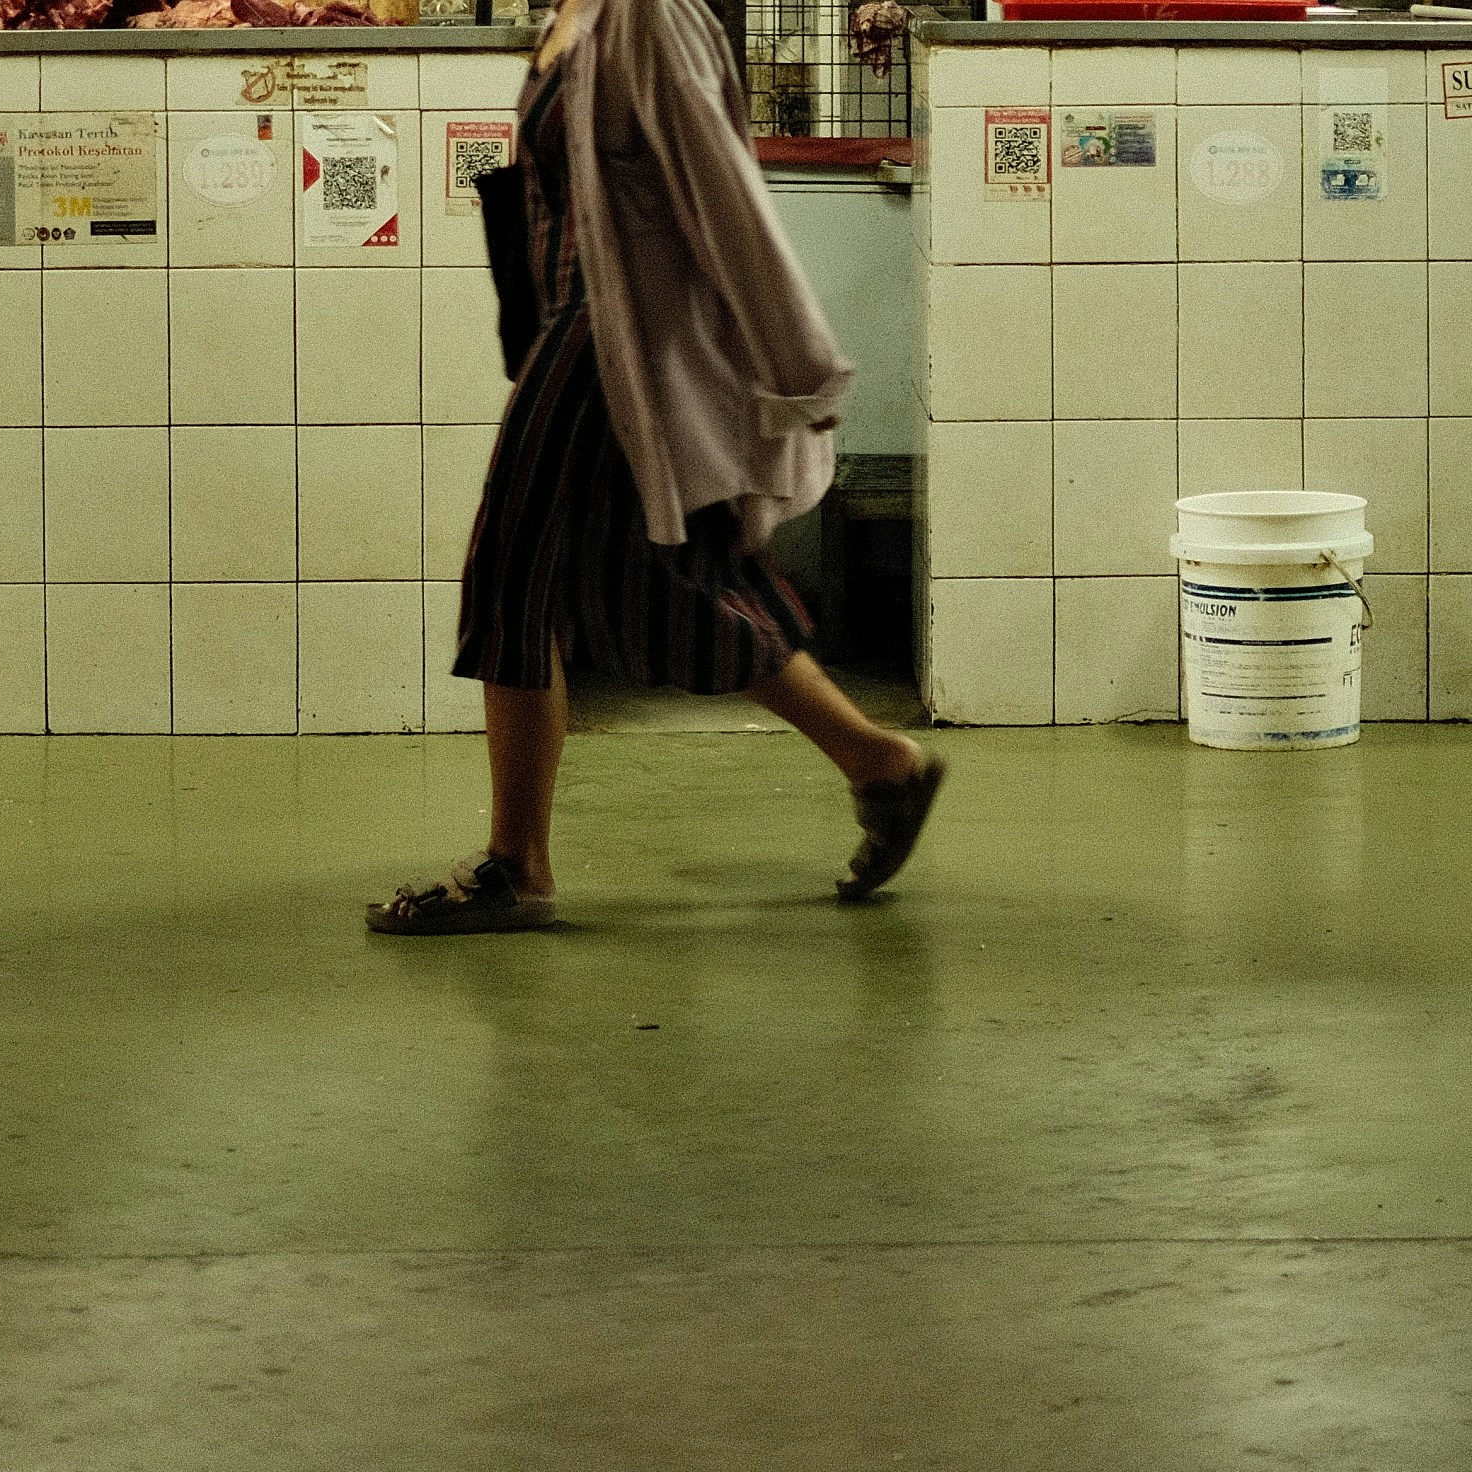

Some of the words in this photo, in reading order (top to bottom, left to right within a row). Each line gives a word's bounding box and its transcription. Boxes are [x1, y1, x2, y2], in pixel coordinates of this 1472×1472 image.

[18, 129, 72, 140] Kawasan
[76, 127, 118, 140] Tertib
[18, 145, 74, 157] Protokol
[78, 145, 142, 157] Kesehatan
[52, 196, 94, 217] 3M
